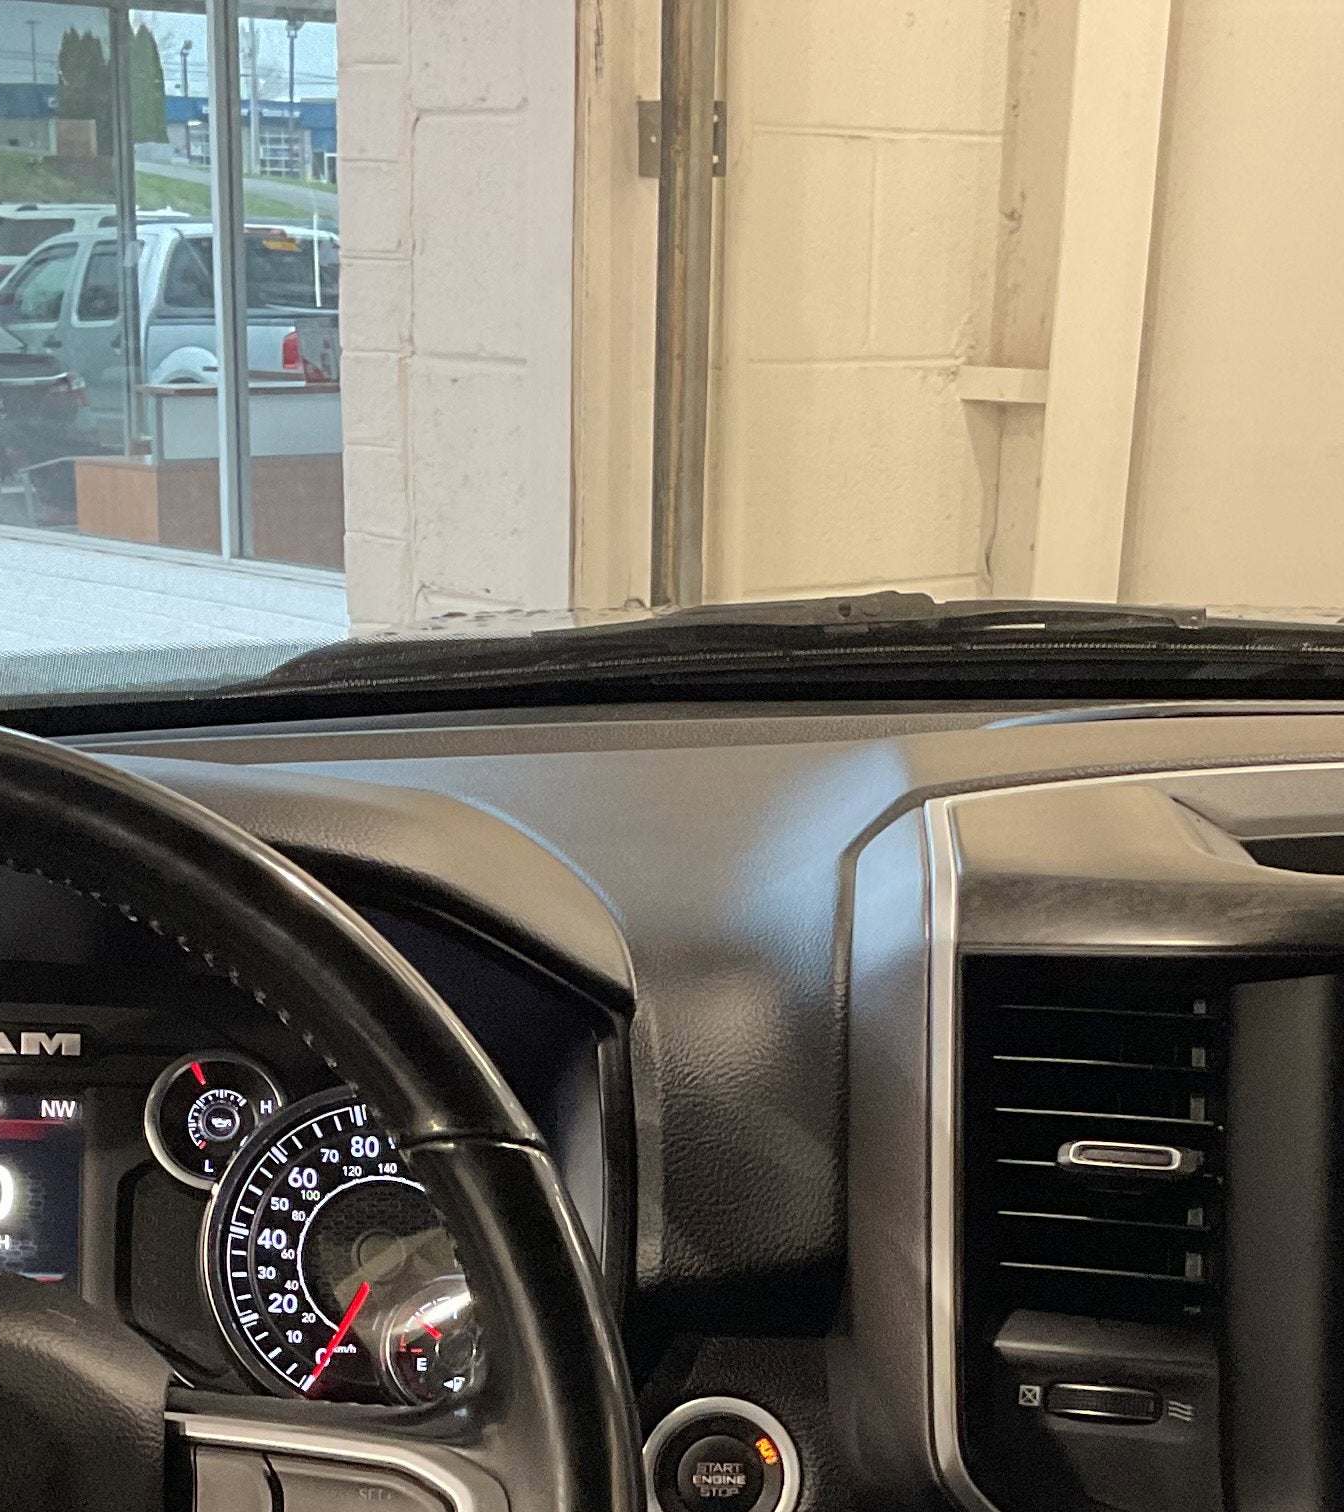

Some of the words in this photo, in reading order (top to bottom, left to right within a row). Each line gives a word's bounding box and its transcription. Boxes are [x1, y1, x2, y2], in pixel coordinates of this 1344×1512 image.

[41, 1099, 76, 1119] NW
[260, 1100, 273, 1114] H
[350, 1135, 380, 1158] 80
[319, 1148, 340, 1164] 70
[204, 1159, 214, 1174] L
[342, 1165, 362, 1177] 120
[377, 1162, 398, 1175] 140
[287, 1167, 318, 1189] 60
[300, 1190, 320, 1201] 100
[270, 1197, 290, 1212] 50
[291, 1210, 306, 1222] 80
[257, 1228, 288, 1250] 40
[281, 1248, 296, 1260] 60
[257, 1266, 277, 1280] 30
[284, 1280, 299, 1291] 40
[268, 1293, 298, 1314] 20
[301, 1312, 316, 1324] 20
[285, 1329, 303, 1344] 10
[415, 1357, 428, 1371] E
[696, 1462, 743, 1473] START
[692, 1475, 746, 1485] ENGINE
[700, 1487, 739, 1498] STOP
